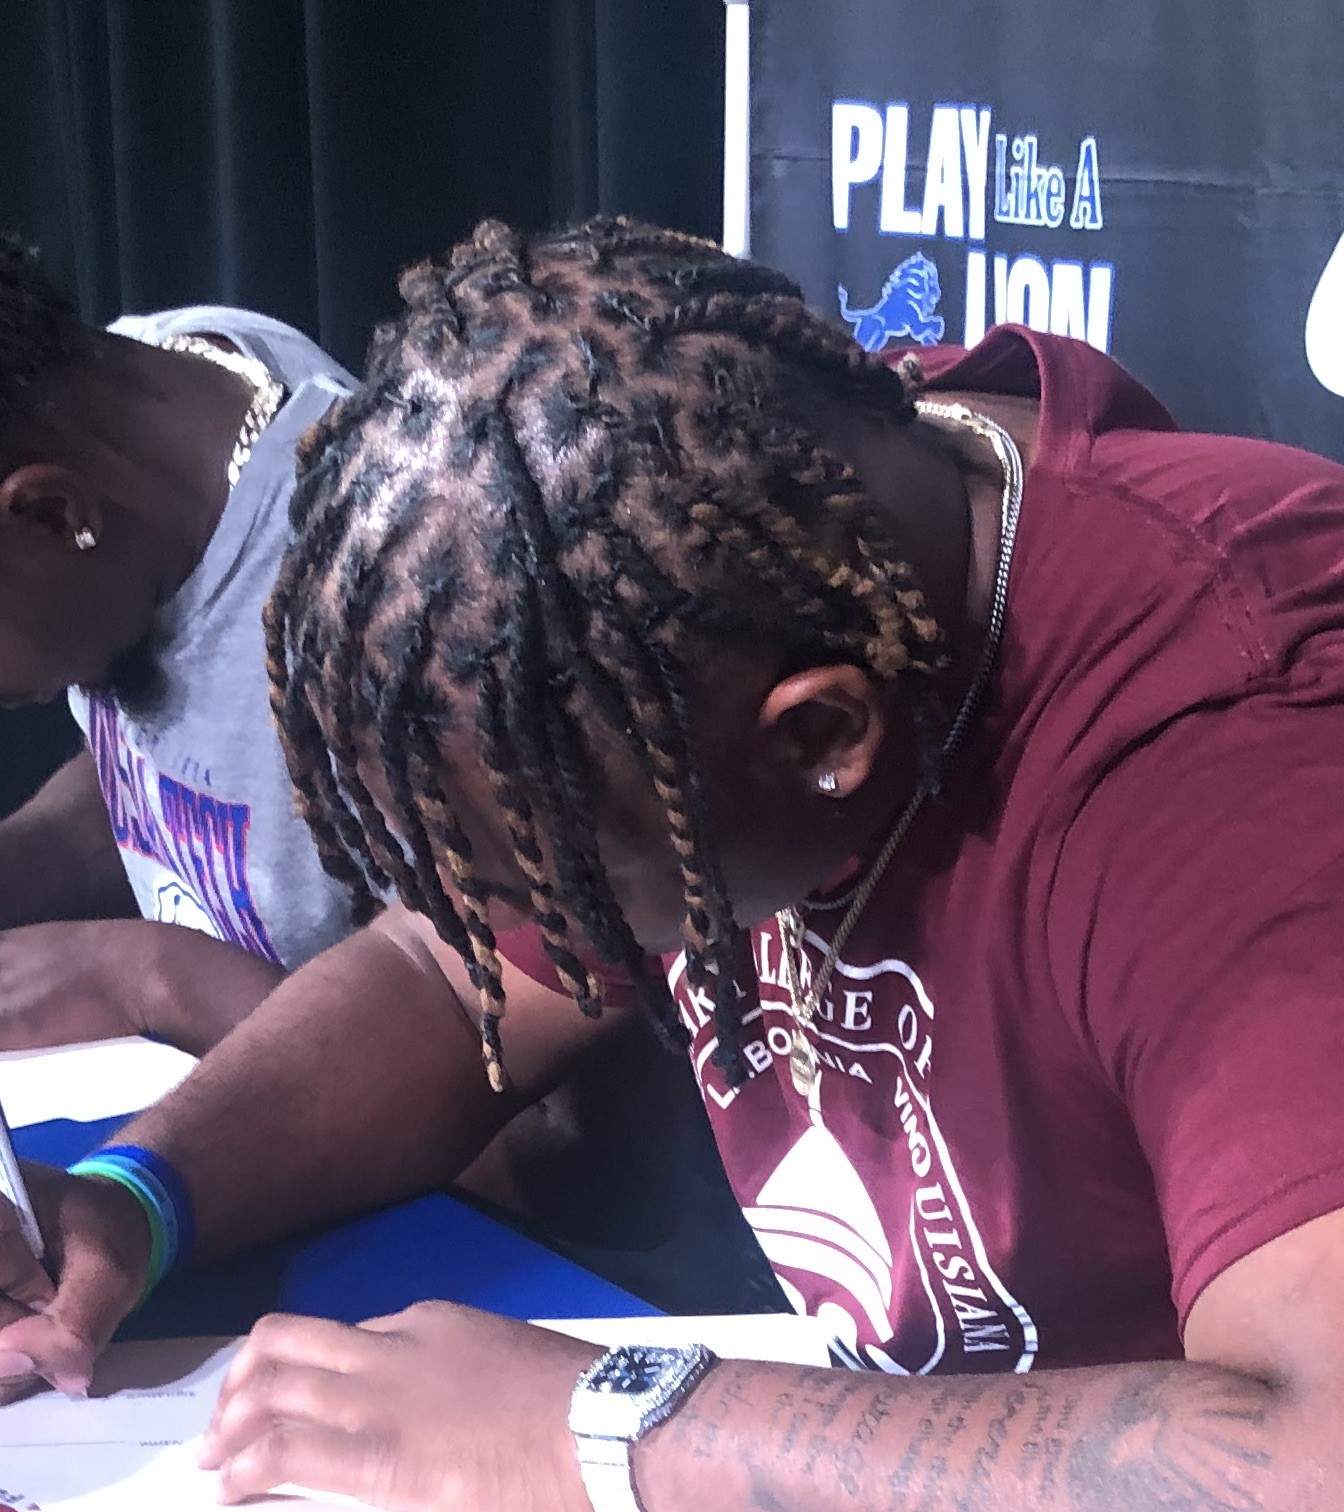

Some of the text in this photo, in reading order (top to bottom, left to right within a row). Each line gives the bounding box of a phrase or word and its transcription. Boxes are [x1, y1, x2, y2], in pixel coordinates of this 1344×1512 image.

[831, 98, 1103, 242] PLAY Like A
